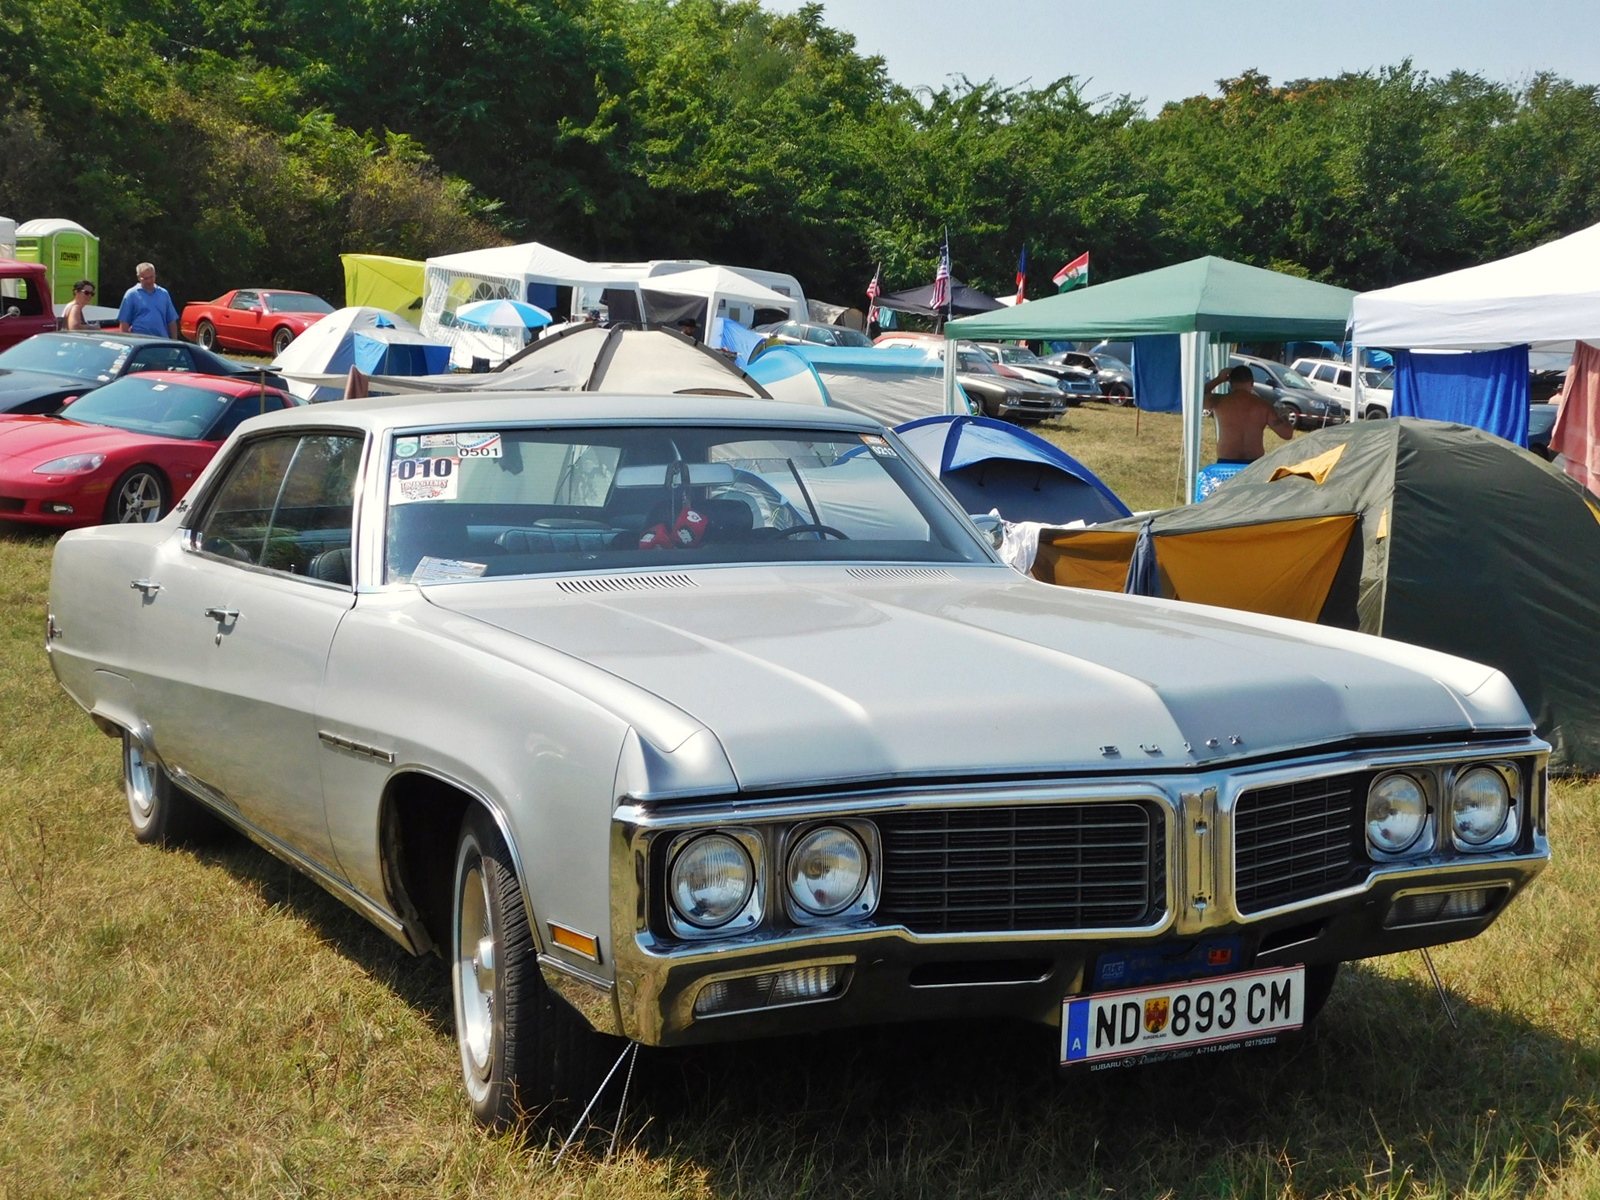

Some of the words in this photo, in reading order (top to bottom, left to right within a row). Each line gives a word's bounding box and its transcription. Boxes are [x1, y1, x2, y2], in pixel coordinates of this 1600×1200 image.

[459, 447, 499, 457] 0501
[397, 458, 453, 480] 010
[1094, 1001, 1141, 1048] ND
[1171, 987, 1237, 1037] 893
[1247, 978, 1291, 1025] CM
[1071, 1037, 1082, 1051] A
[1090, 1060, 1122, 1072] SUBARU
